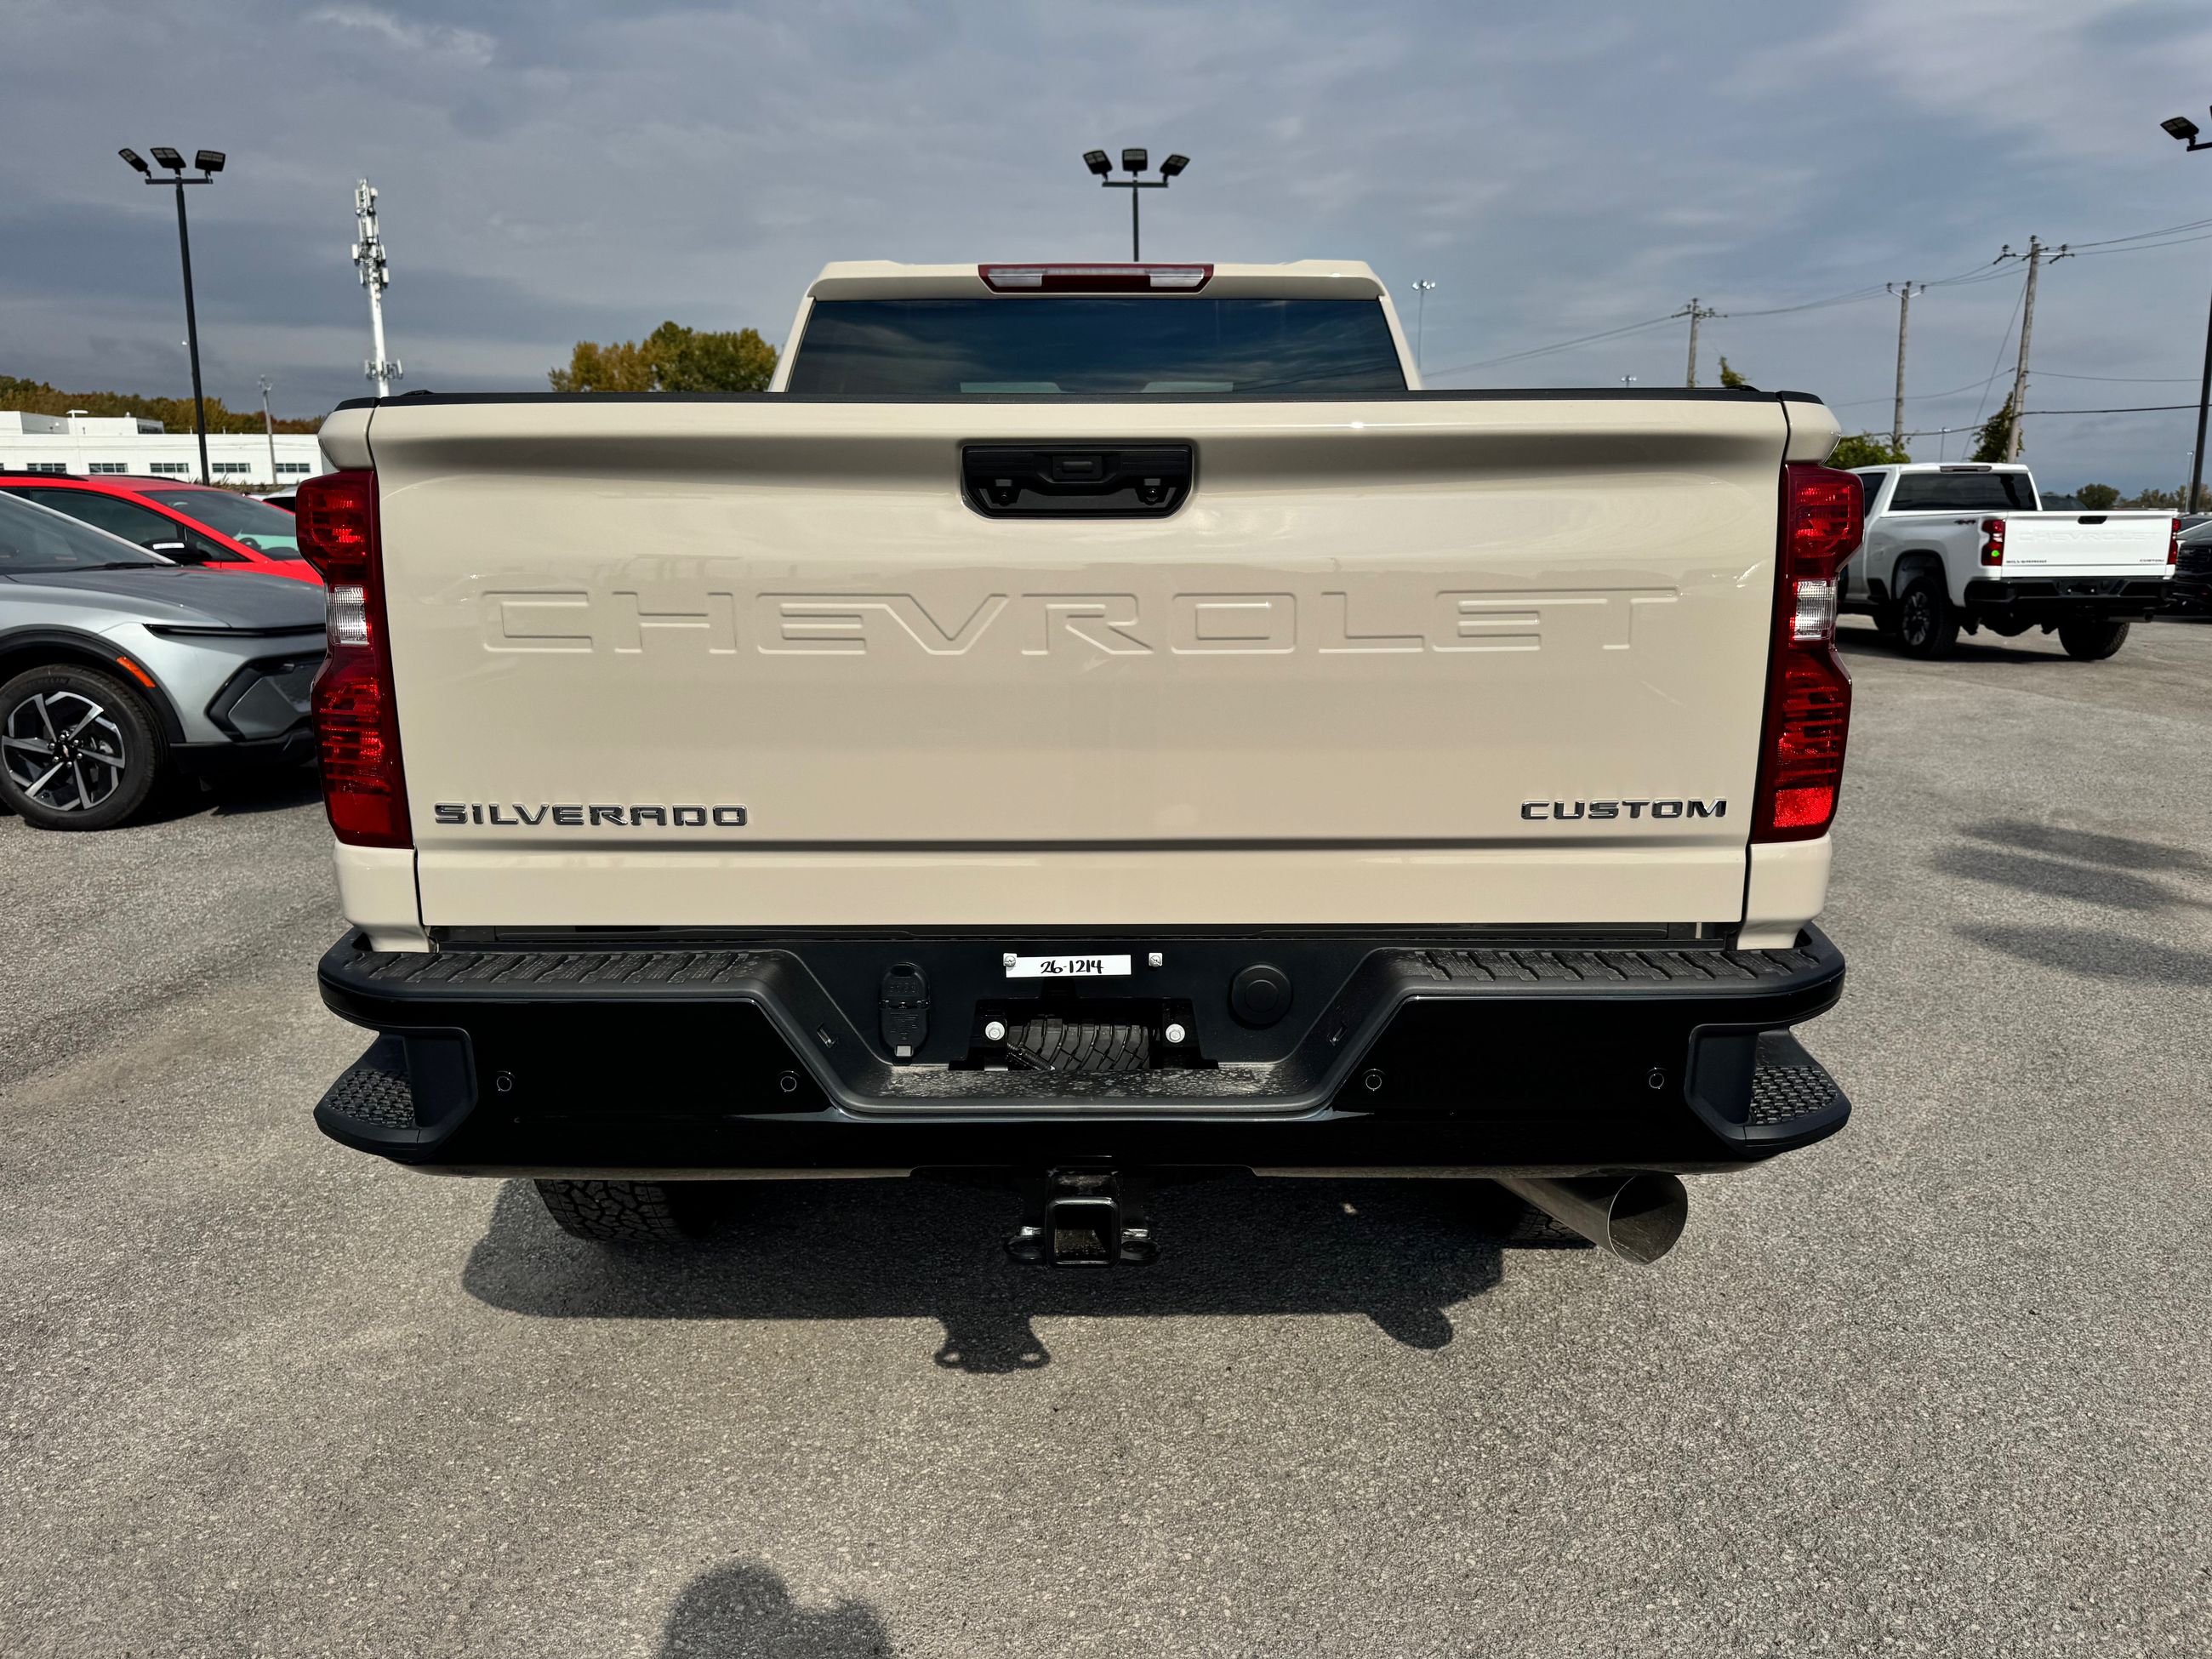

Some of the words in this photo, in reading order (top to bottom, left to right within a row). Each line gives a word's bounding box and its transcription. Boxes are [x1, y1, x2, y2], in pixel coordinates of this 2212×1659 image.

[482, 587, 1679, 656] CHEVROLET
[434, 802, 749, 827] SILVERADO
[1520, 798, 1728, 820] CUSTOM
[1040, 959, 1105, 975] 26-1214
